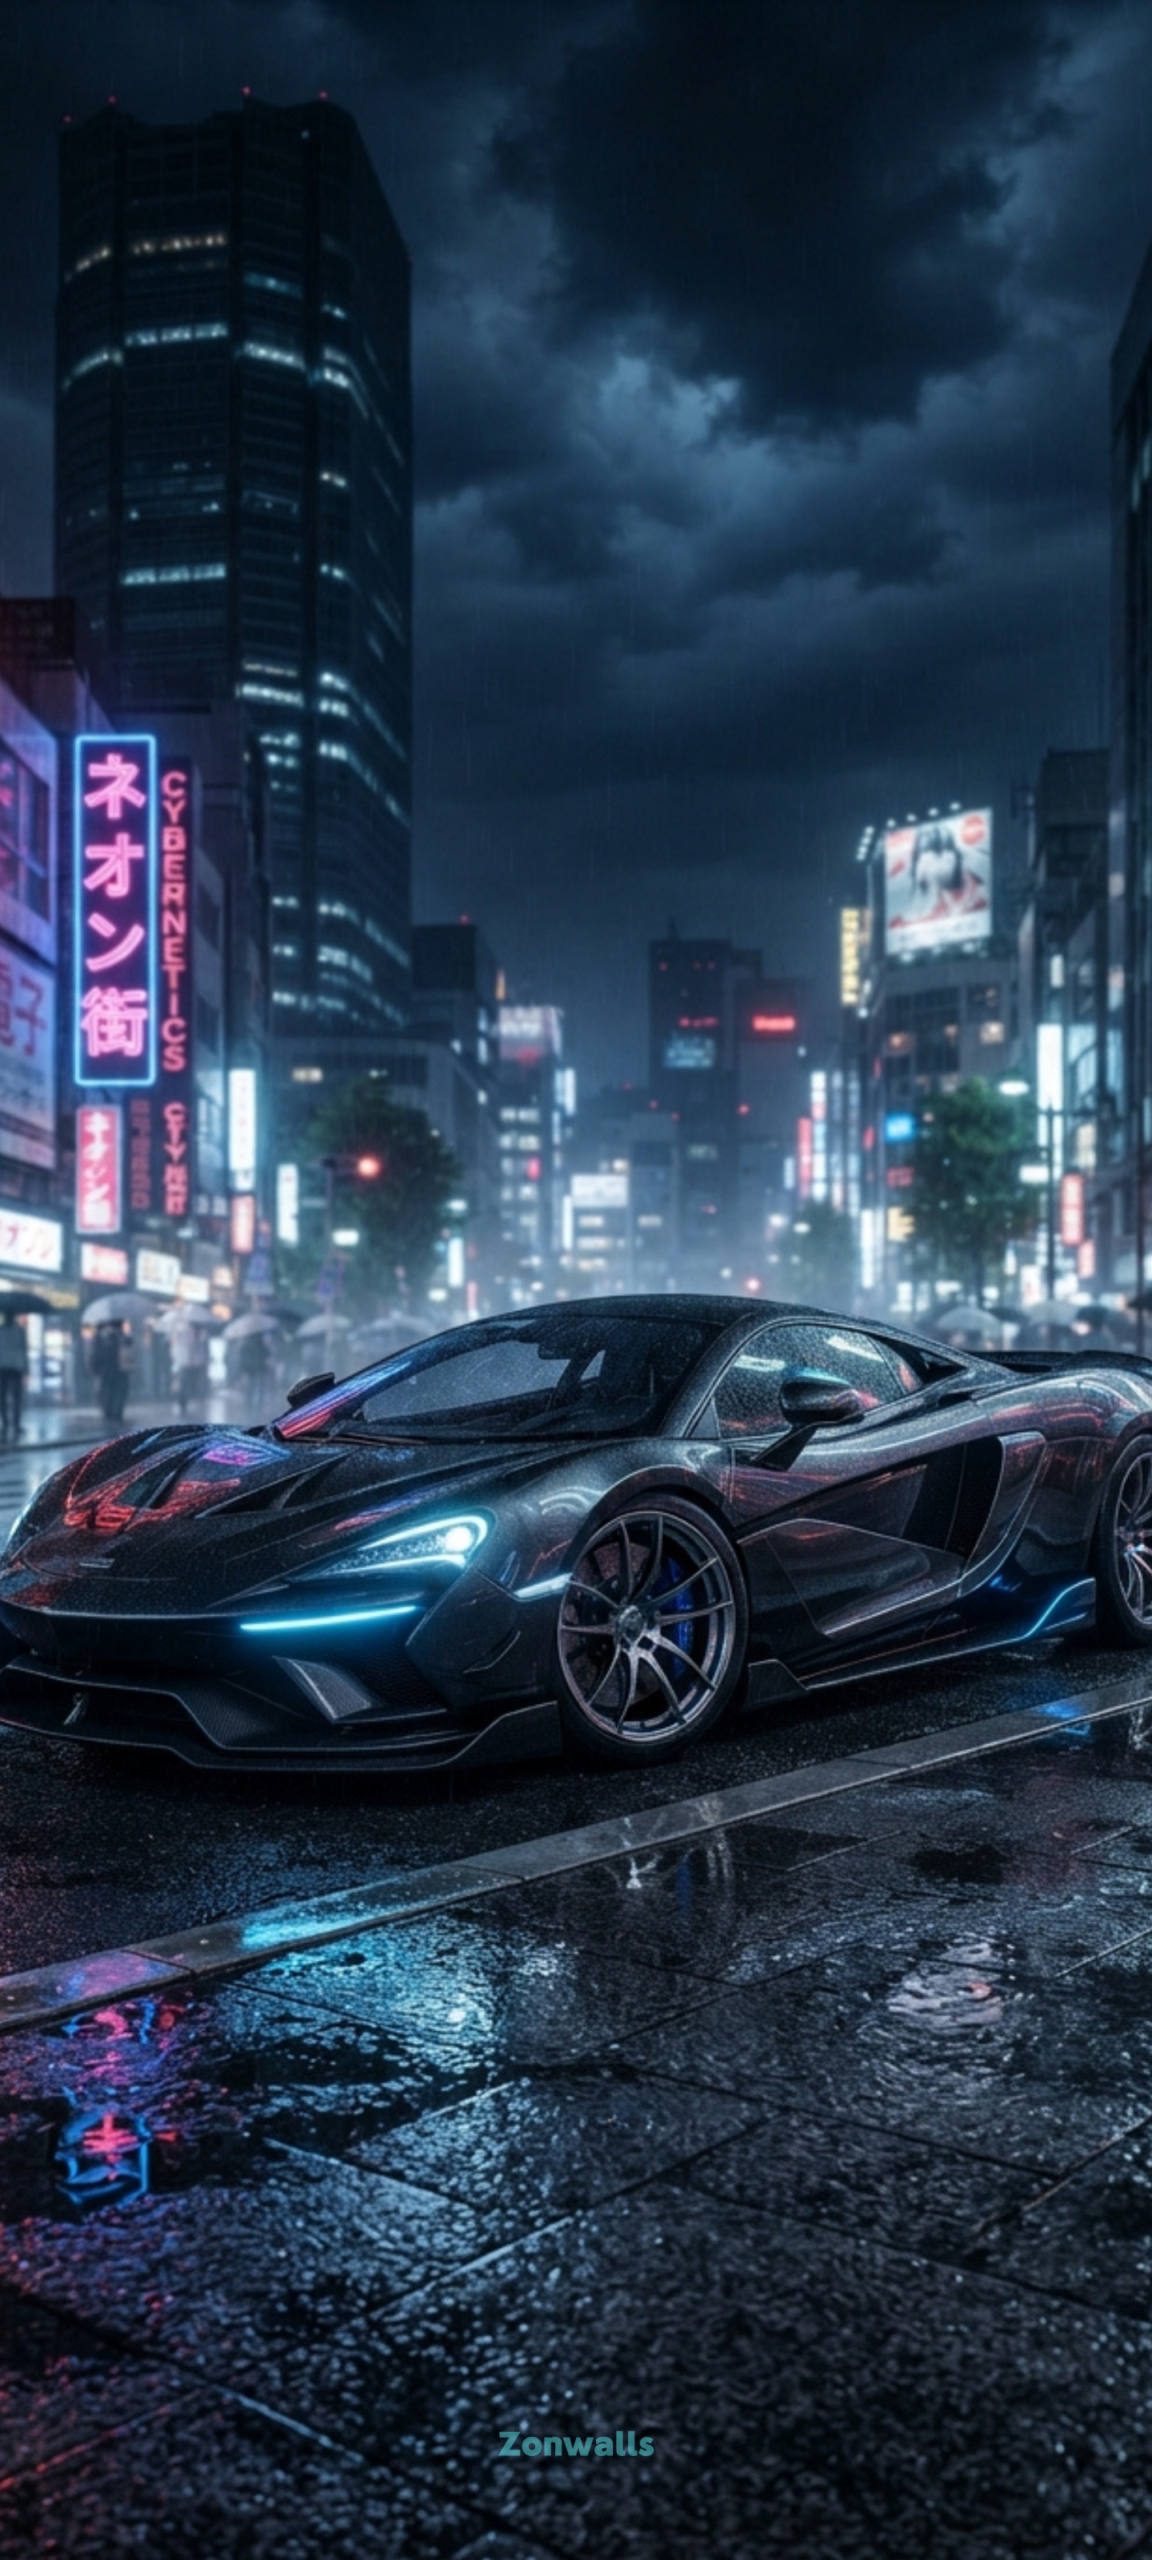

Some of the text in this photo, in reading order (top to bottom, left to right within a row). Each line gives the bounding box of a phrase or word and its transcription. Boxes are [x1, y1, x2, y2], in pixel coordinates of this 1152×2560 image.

[82, 753, 148, 1057] ネオン街
[162, 771, 188, 1071] CYBERNETICS
